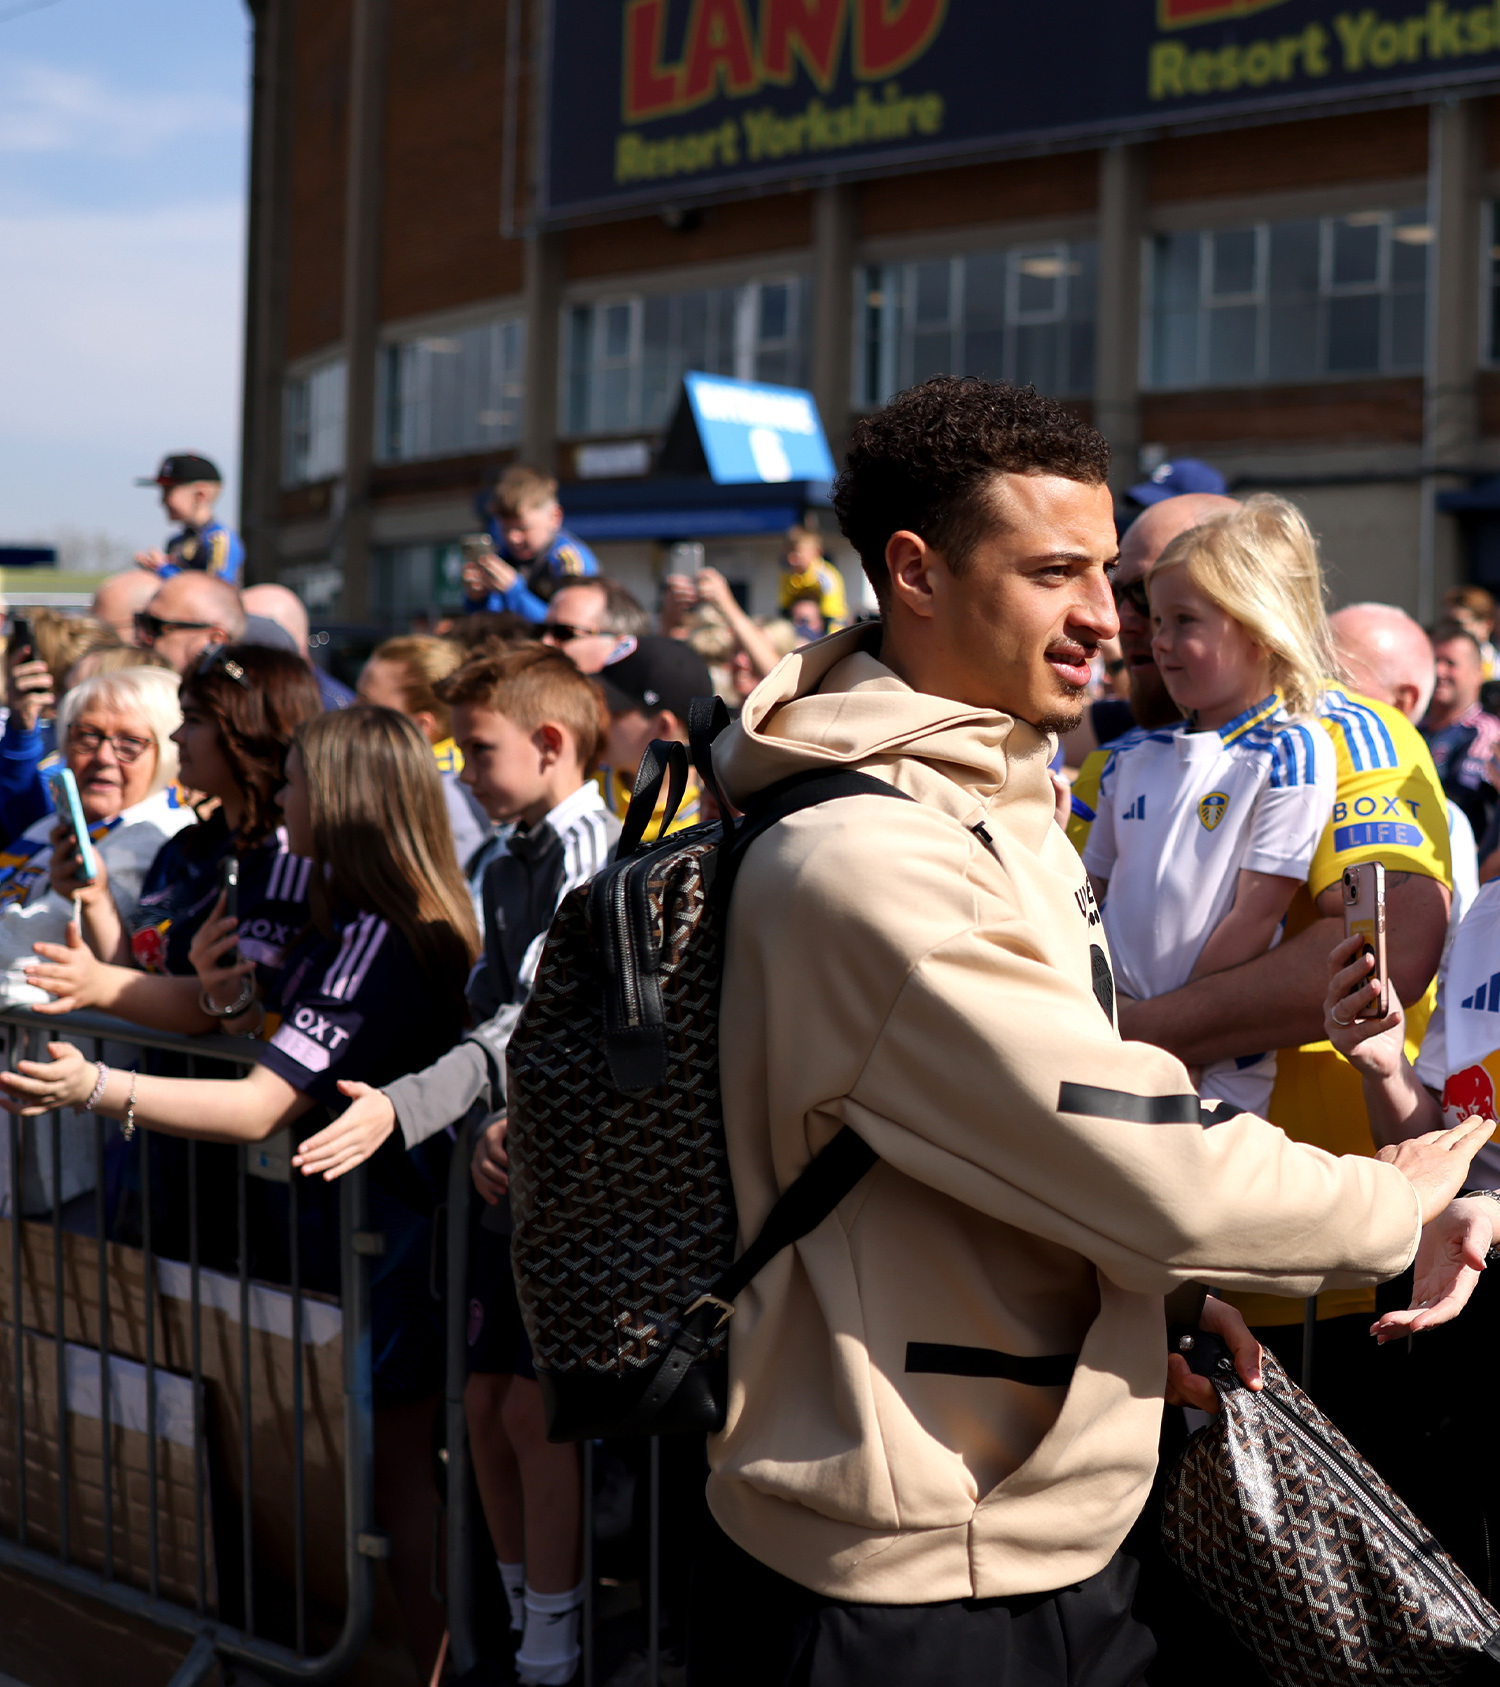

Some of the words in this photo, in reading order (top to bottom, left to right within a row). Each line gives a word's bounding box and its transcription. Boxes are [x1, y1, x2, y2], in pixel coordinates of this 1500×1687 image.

[1148, 24, 1330, 98] Resort
[614, 117, 740, 184] Resort
[743, 82, 945, 162] Yorkshire
[1333, 796, 1421, 823] BOXT
[1348, 823, 1409, 846] LIFE
[294, 1005, 350, 1050] OXT
